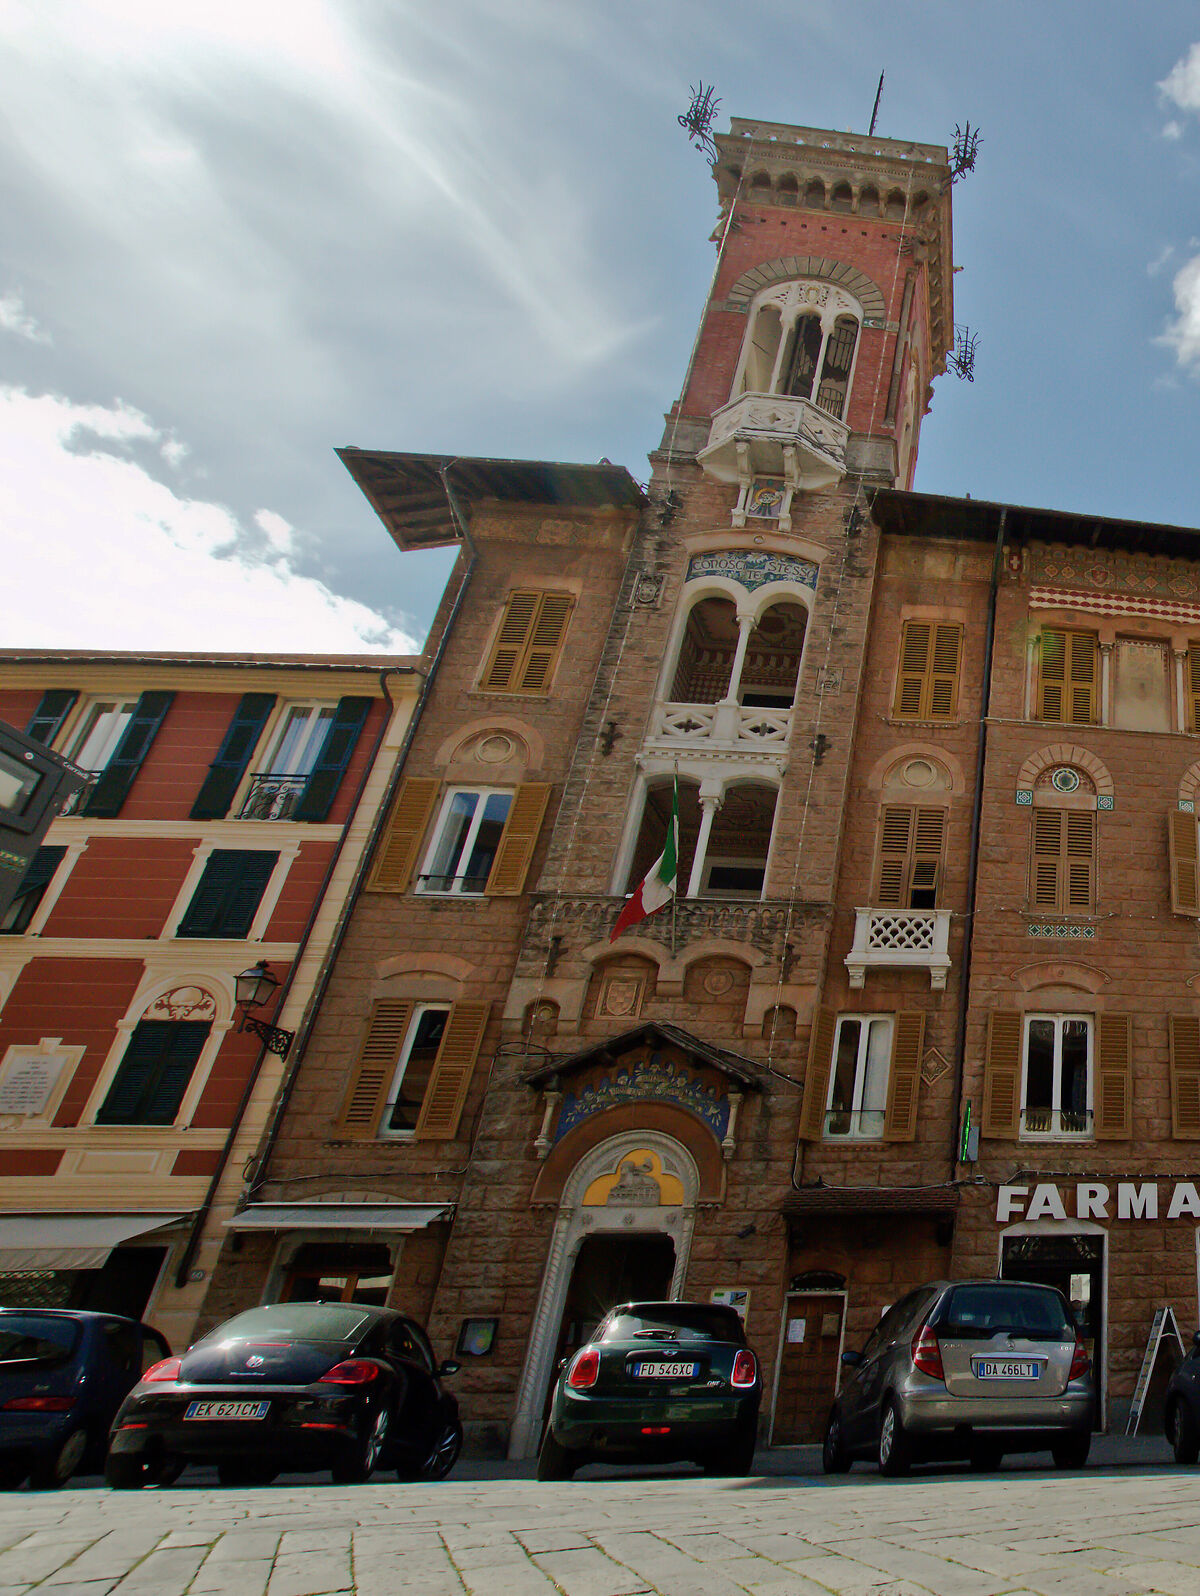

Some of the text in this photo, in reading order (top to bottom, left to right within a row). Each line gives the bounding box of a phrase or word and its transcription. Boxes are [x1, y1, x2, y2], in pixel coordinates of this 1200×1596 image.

[748, 570, 761, 580] TE
[767, 561, 816, 578] STESSO
[640, 1363, 693, 1376] FD 546XC
[985, 1364, 1032, 1376] DA 466LT
[195, 1403, 261, 1416] EK 621CM
